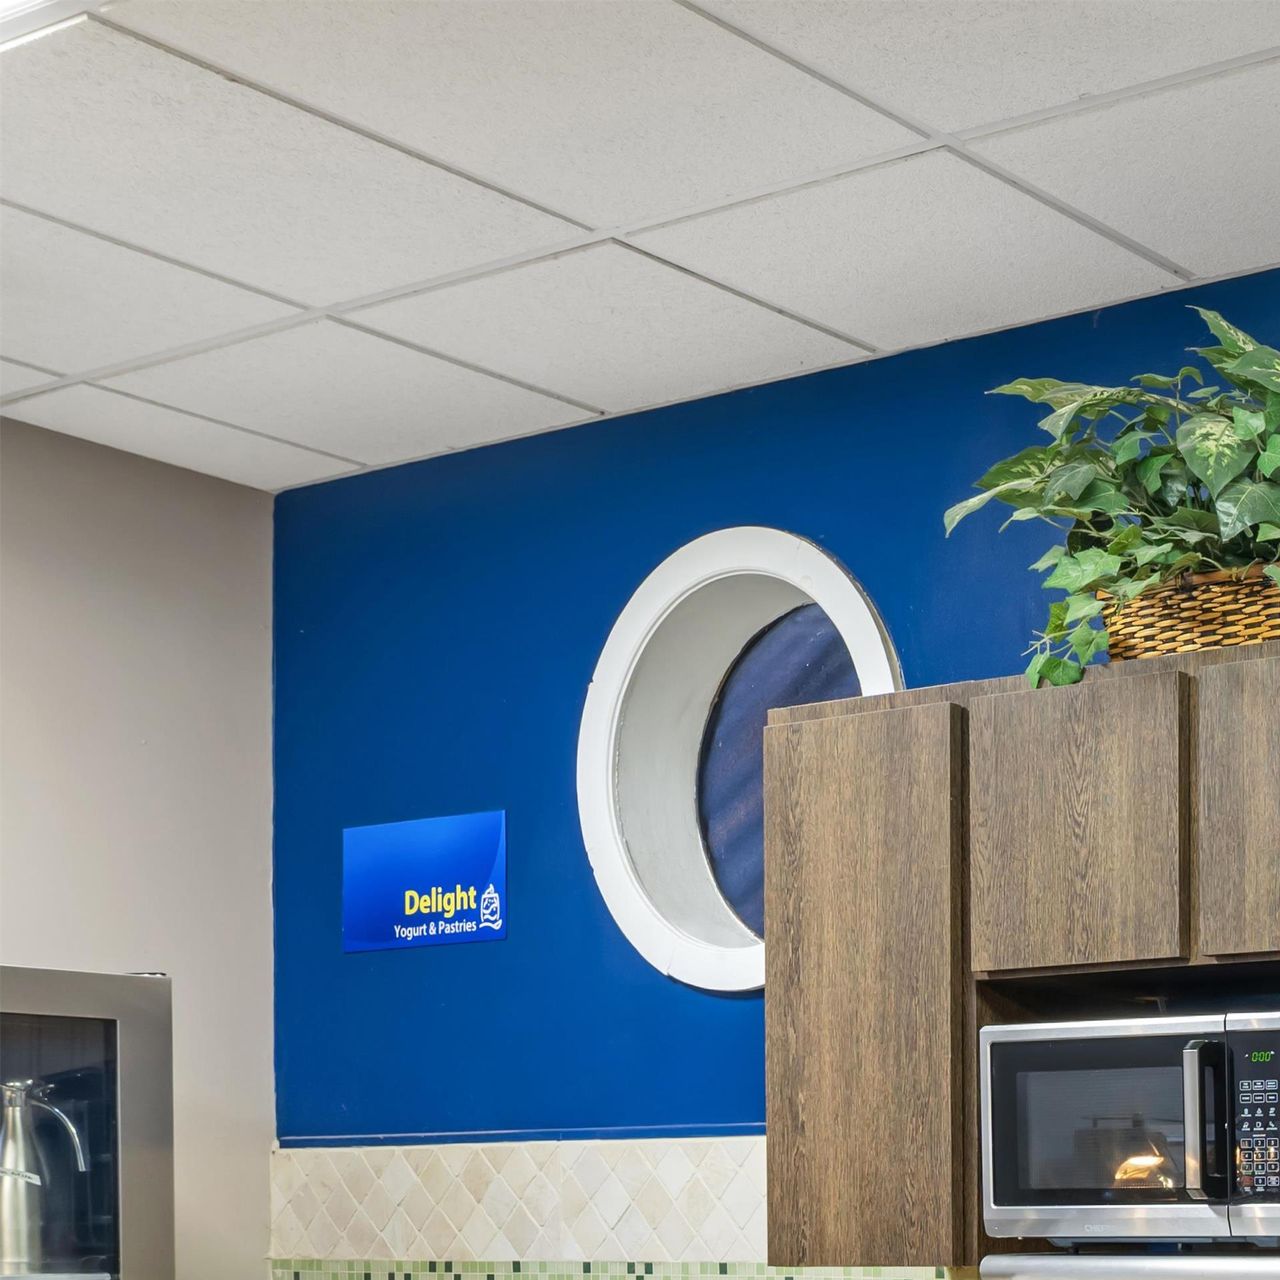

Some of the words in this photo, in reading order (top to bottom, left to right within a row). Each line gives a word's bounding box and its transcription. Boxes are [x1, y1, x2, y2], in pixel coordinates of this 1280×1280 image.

[404, 884, 477, 918] Delight
[394, 923, 427, 940] Yogurt
[429, 922, 436, 935] &
[438, 919, 477, 935] Pastries
